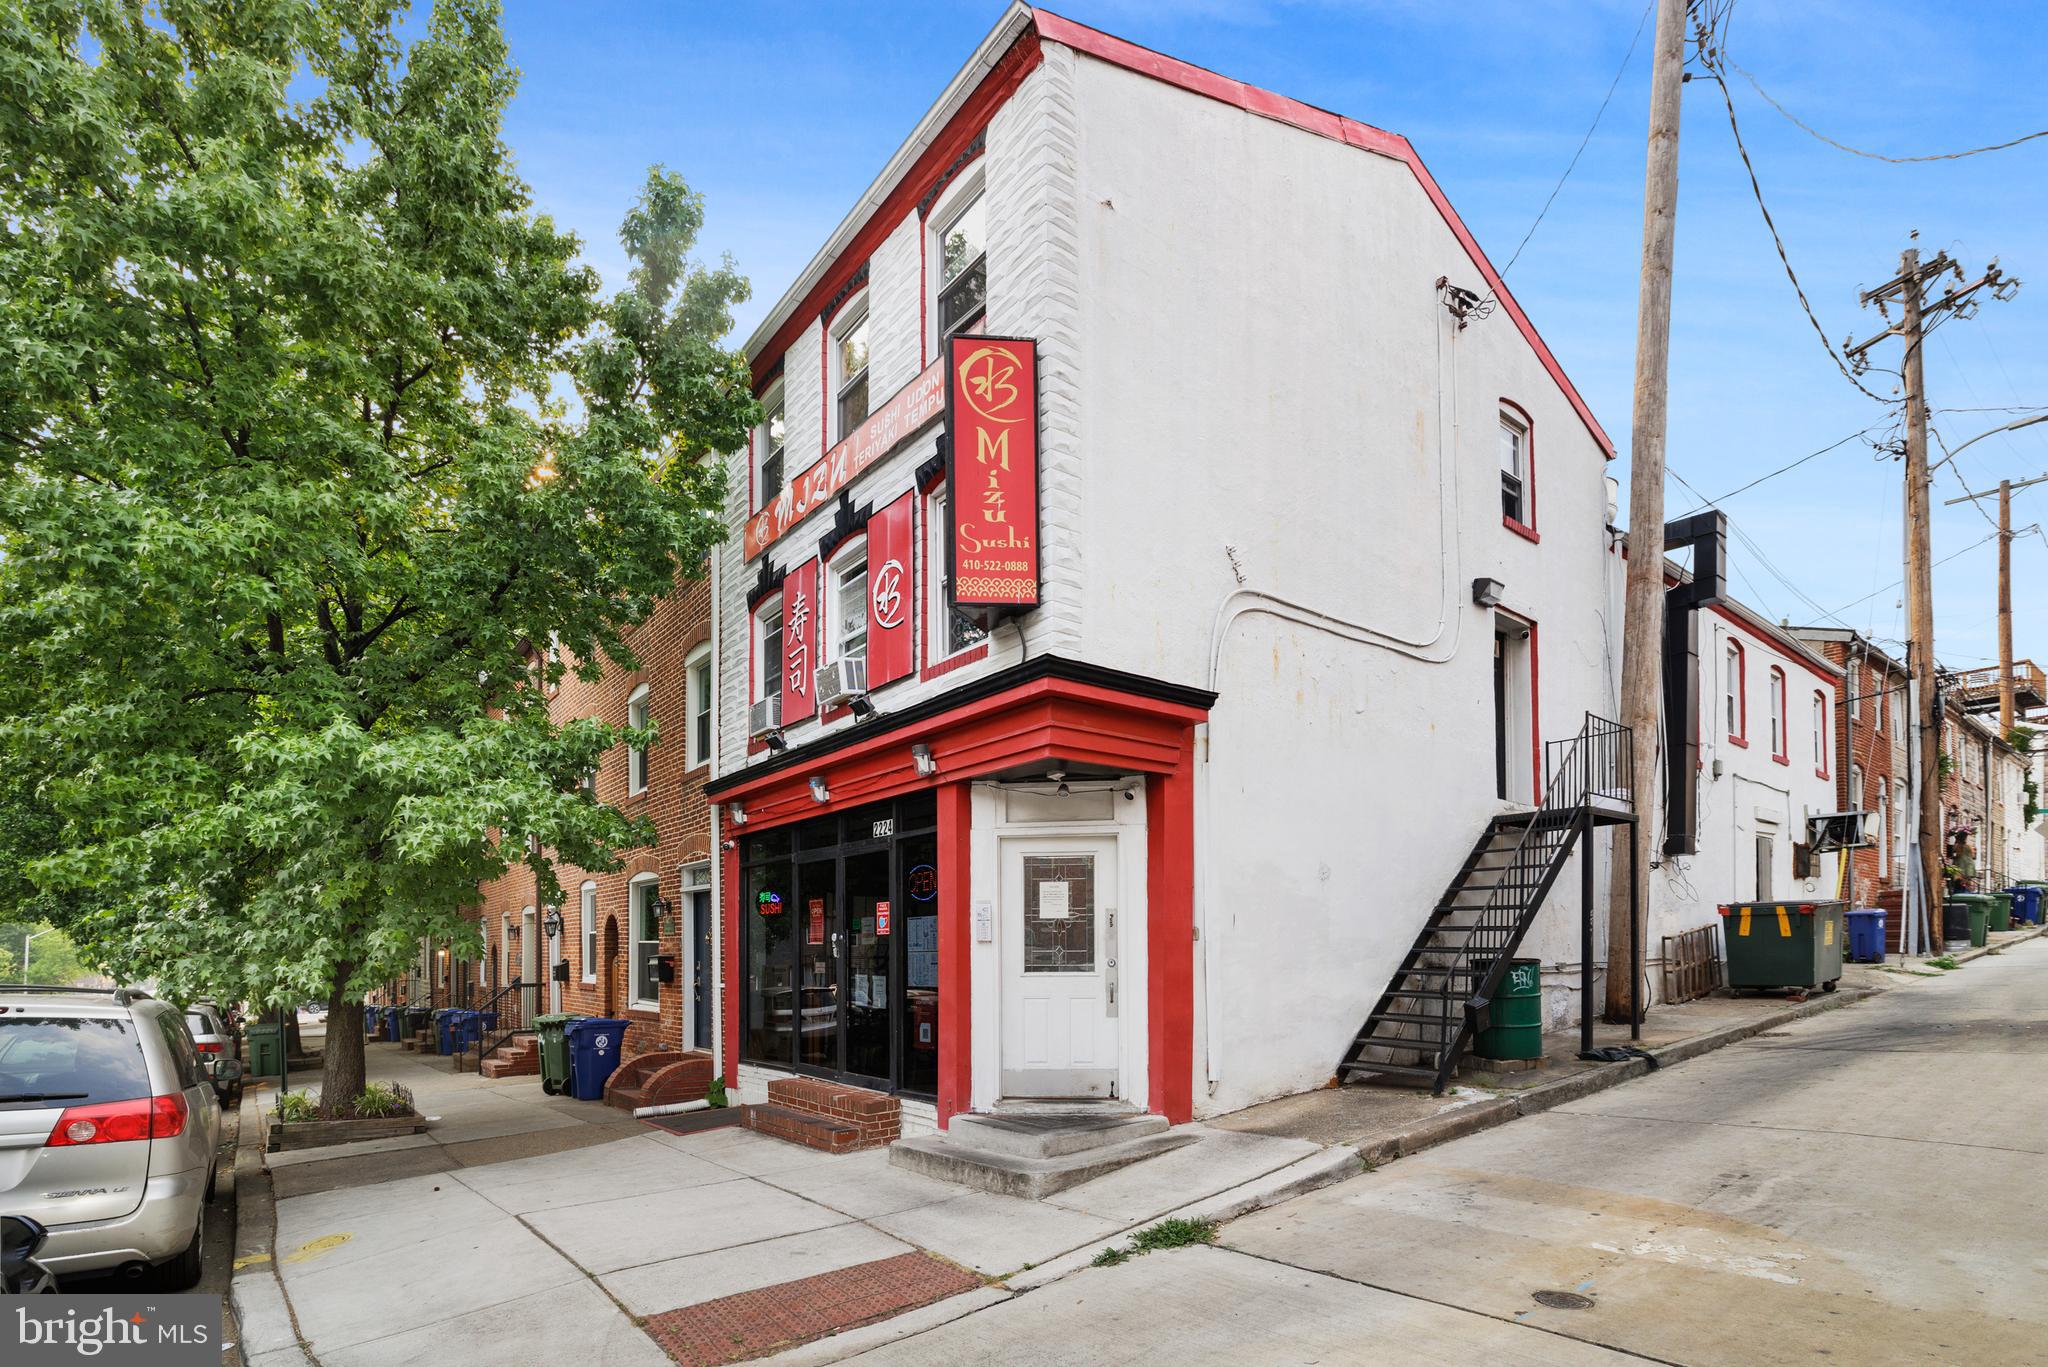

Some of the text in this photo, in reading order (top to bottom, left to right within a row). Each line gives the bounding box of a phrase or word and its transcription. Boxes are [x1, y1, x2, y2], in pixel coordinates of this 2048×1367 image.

[870, 371, 940, 439] SUSHI UDON
[853, 422, 898, 470] TERIYAKI
[960, 523, 1031, 553] Sushi
[962, 559, 1029, 571] 410-522-0888
[787, 591, 811, 697] 寿司
[874, 821, 893, 837] 2224
[760, 902, 783, 915] SUSHI
[43, 1187, 107, 1199] SIENNA
